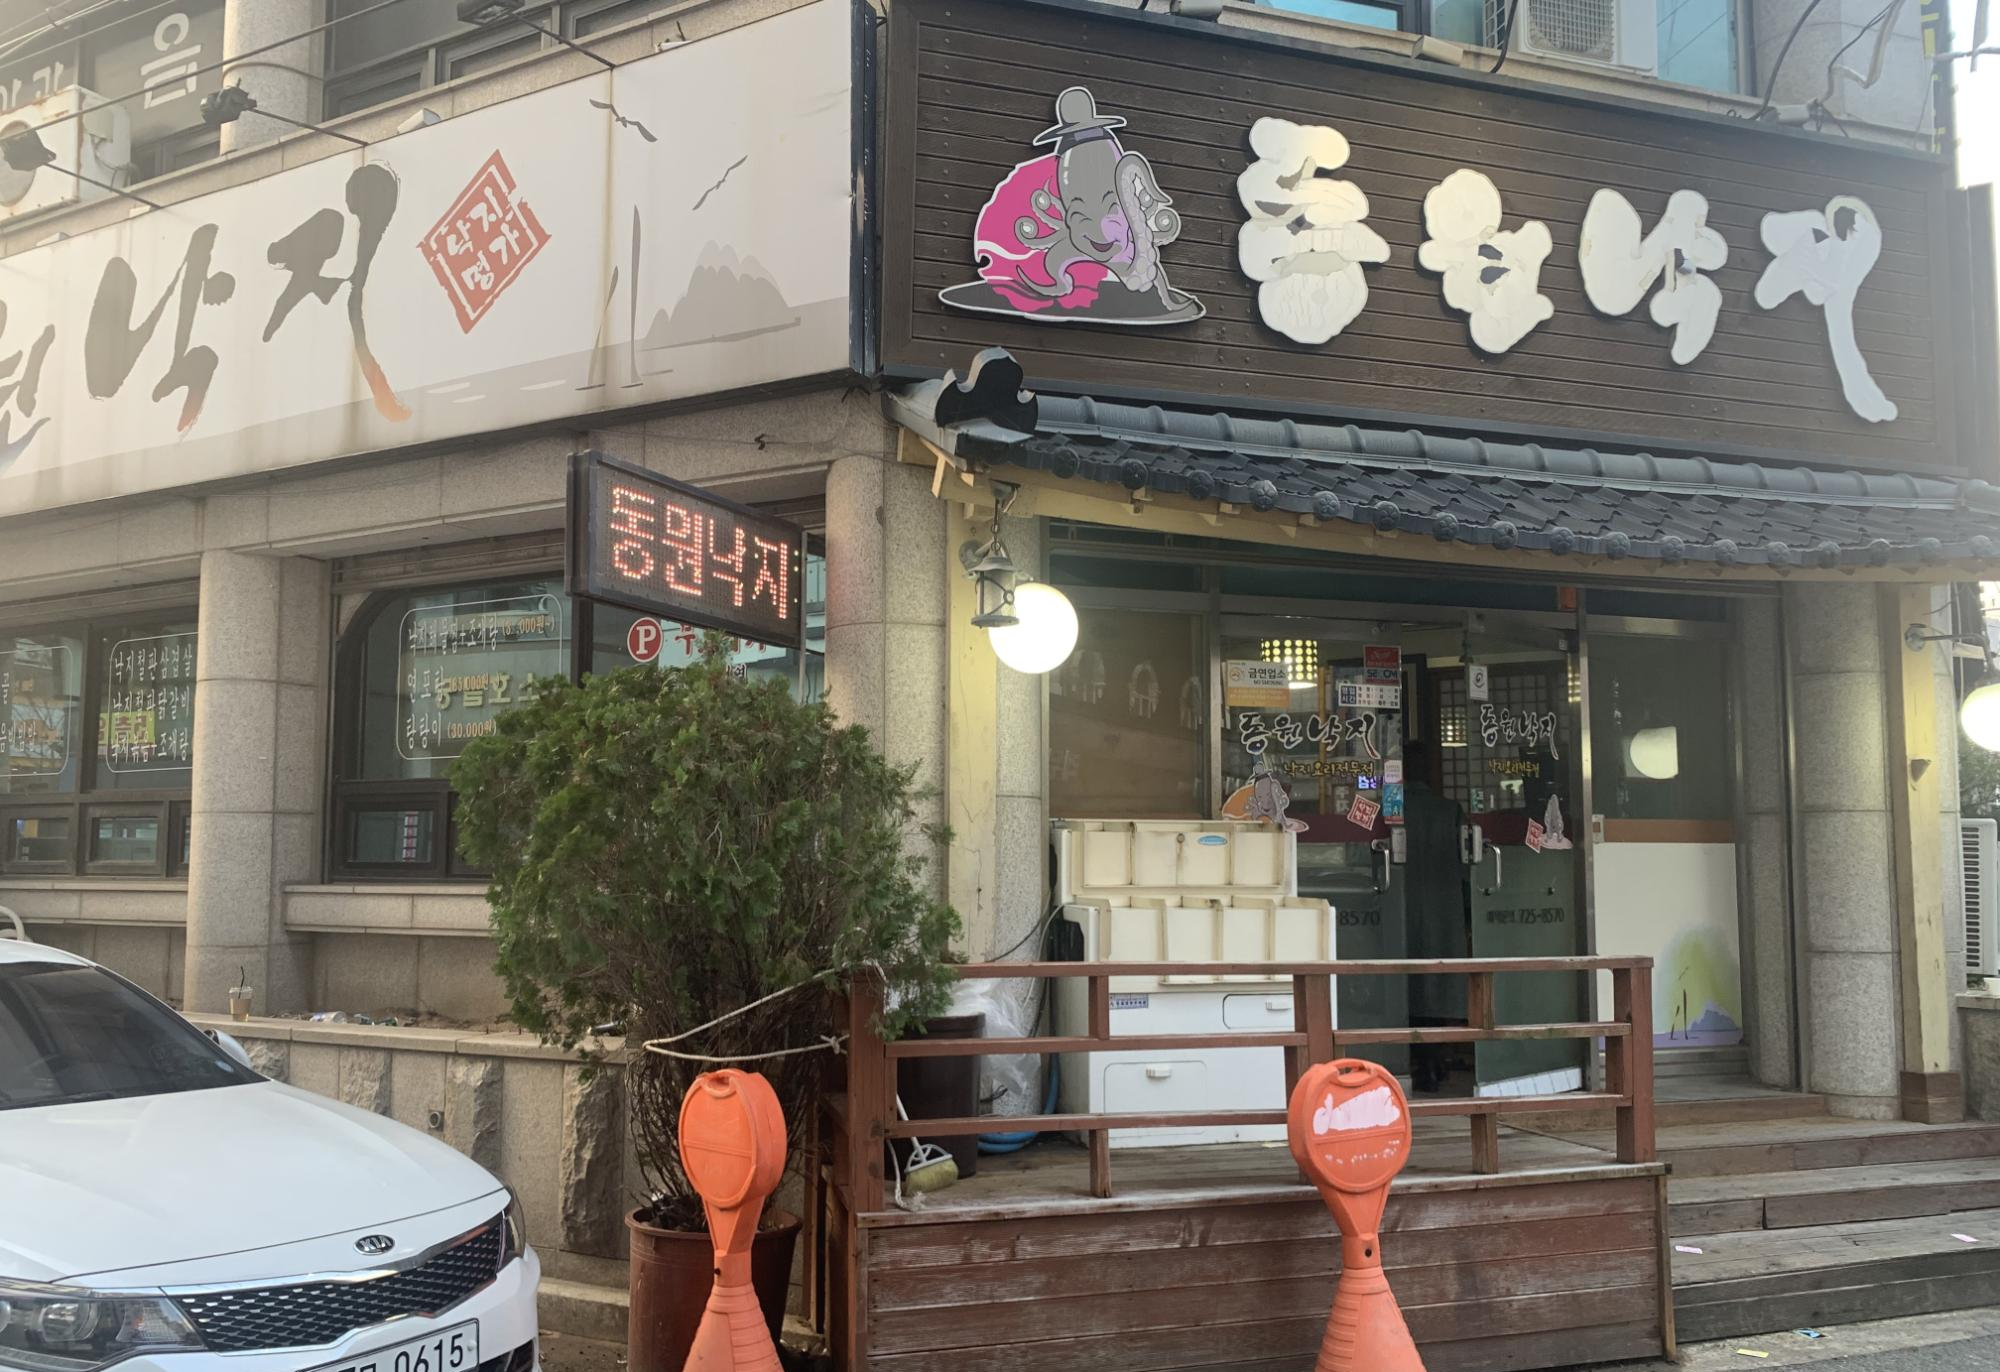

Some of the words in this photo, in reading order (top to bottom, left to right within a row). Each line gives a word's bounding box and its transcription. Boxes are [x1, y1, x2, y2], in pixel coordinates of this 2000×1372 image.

[1237, 117, 1898, 423] 동원낙지
[610, 486, 789, 620] 동원낙지
[636, 625, 657, 655] P
[1248, 667, 1286, 680] 금연업소
[1367, 669, 1398, 678] SEOM
[406, 713, 442, 749] 탕탕이
[1239, 711, 1381, 759] 동원낙지
[1480, 703, 1559, 761] 동원낙지
[394, 1332, 463, 1372] 0615
